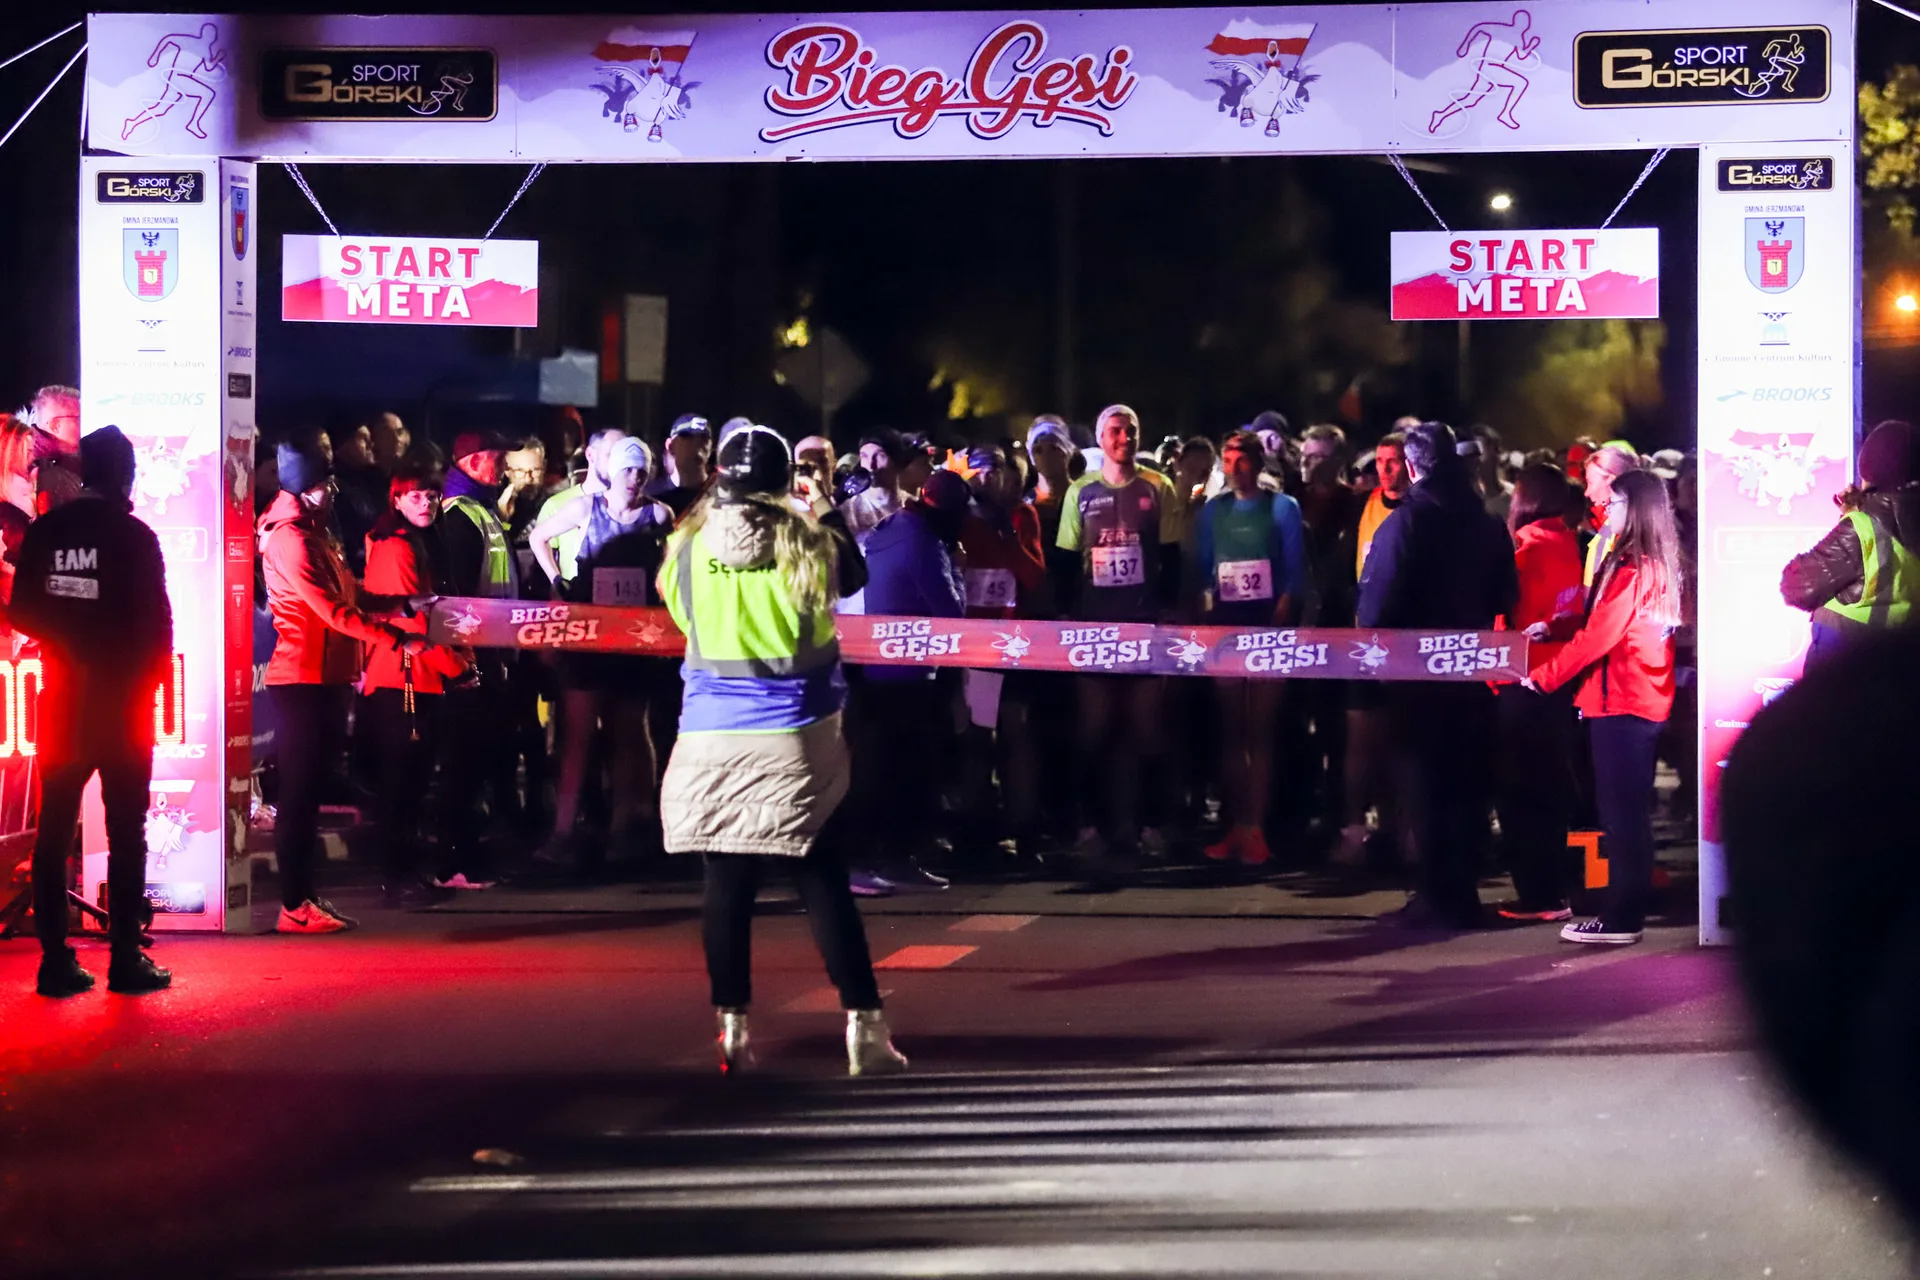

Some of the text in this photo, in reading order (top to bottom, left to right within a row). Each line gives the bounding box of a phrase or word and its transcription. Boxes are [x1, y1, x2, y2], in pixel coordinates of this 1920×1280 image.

[1673, 46, 1748, 65] SPORT
[352, 64, 420, 82] SPORT
[1602, 47, 1749, 89] GÓRSKI
[285, 64, 424, 104] GÓRSKI
[766, 20, 1138, 138] Bieg Gęsi
[1728, 165, 1798, 185] GÓRSKI
[1762, 164, 1797, 175] SPORT
[107, 177, 172, 197] GÓRSKI
[138, 178, 171, 187] SPORT
[1744, 205, 1764, 213] GMINA
[341, 243, 481, 281] START
[1449, 238, 1595, 274] START
[347, 283, 470, 320] META
[1457, 276, 1587, 314] META
[131, 392, 206, 406] BROOKS
[1751, 386, 1833, 402] BROOKS
[51, 546, 98, 572] EAM
[1109, 558, 1138, 577] 137
[612, 579, 642, 598] 143
[986, 581, 1007, 598] 45
[1241, 572, 1261, 591] 32
[510, 605, 570, 625] BIEG
[516, 618, 600, 647] GĘSI
[872, 619, 932, 639] BIEG
[1059, 626, 1121, 646] BIEG
[879, 632, 962, 661] GĘSI
[1235, 630, 1298, 651] BIEG
[1417, 632, 1480, 653] BIEG
[1067, 638, 1152, 668] GĘSI
[1245, 642, 1329, 672] GĘSI
[1426, 646, 1511, 676] GĘSI
